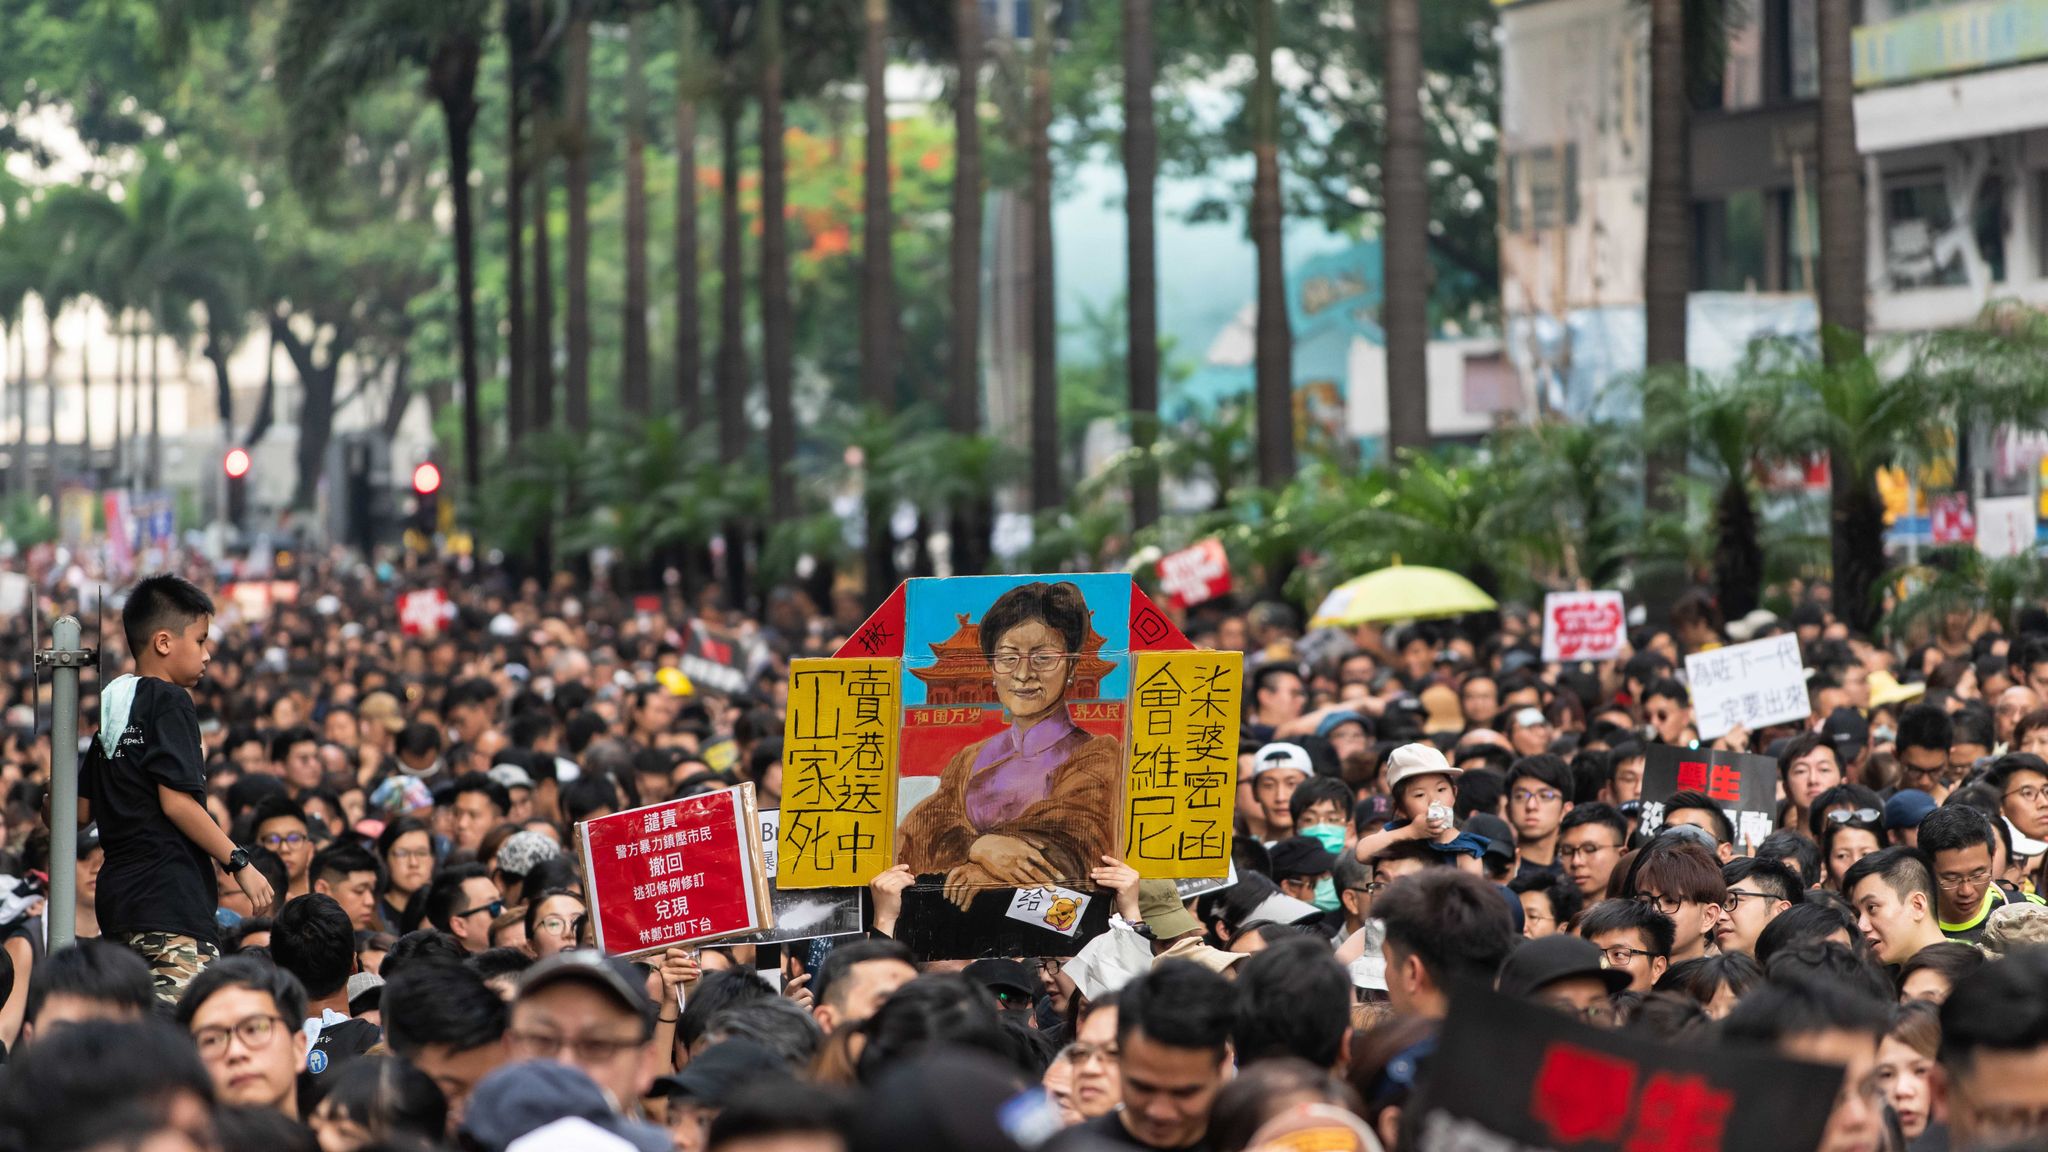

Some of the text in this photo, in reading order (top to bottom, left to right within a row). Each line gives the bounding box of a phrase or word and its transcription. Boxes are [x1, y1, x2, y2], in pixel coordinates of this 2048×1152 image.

[1131, 607, 1169, 645] 回
[913, 707, 983, 725] 和国万岁
[834, 664, 891, 874] 賣港送中
[1125, 661, 1187, 860] 會維尼
[1178, 664, 1231, 861] 柒婆密函
[643, 808, 678, 834] 譴責
[615, 826, 713, 860] 警方暴力鎮壓市民
[649, 852, 684, 878] 撤回
[633, 872, 705, 901] 逃犯條例修訂
[638, 916, 712, 945] 林鄭立即下台
